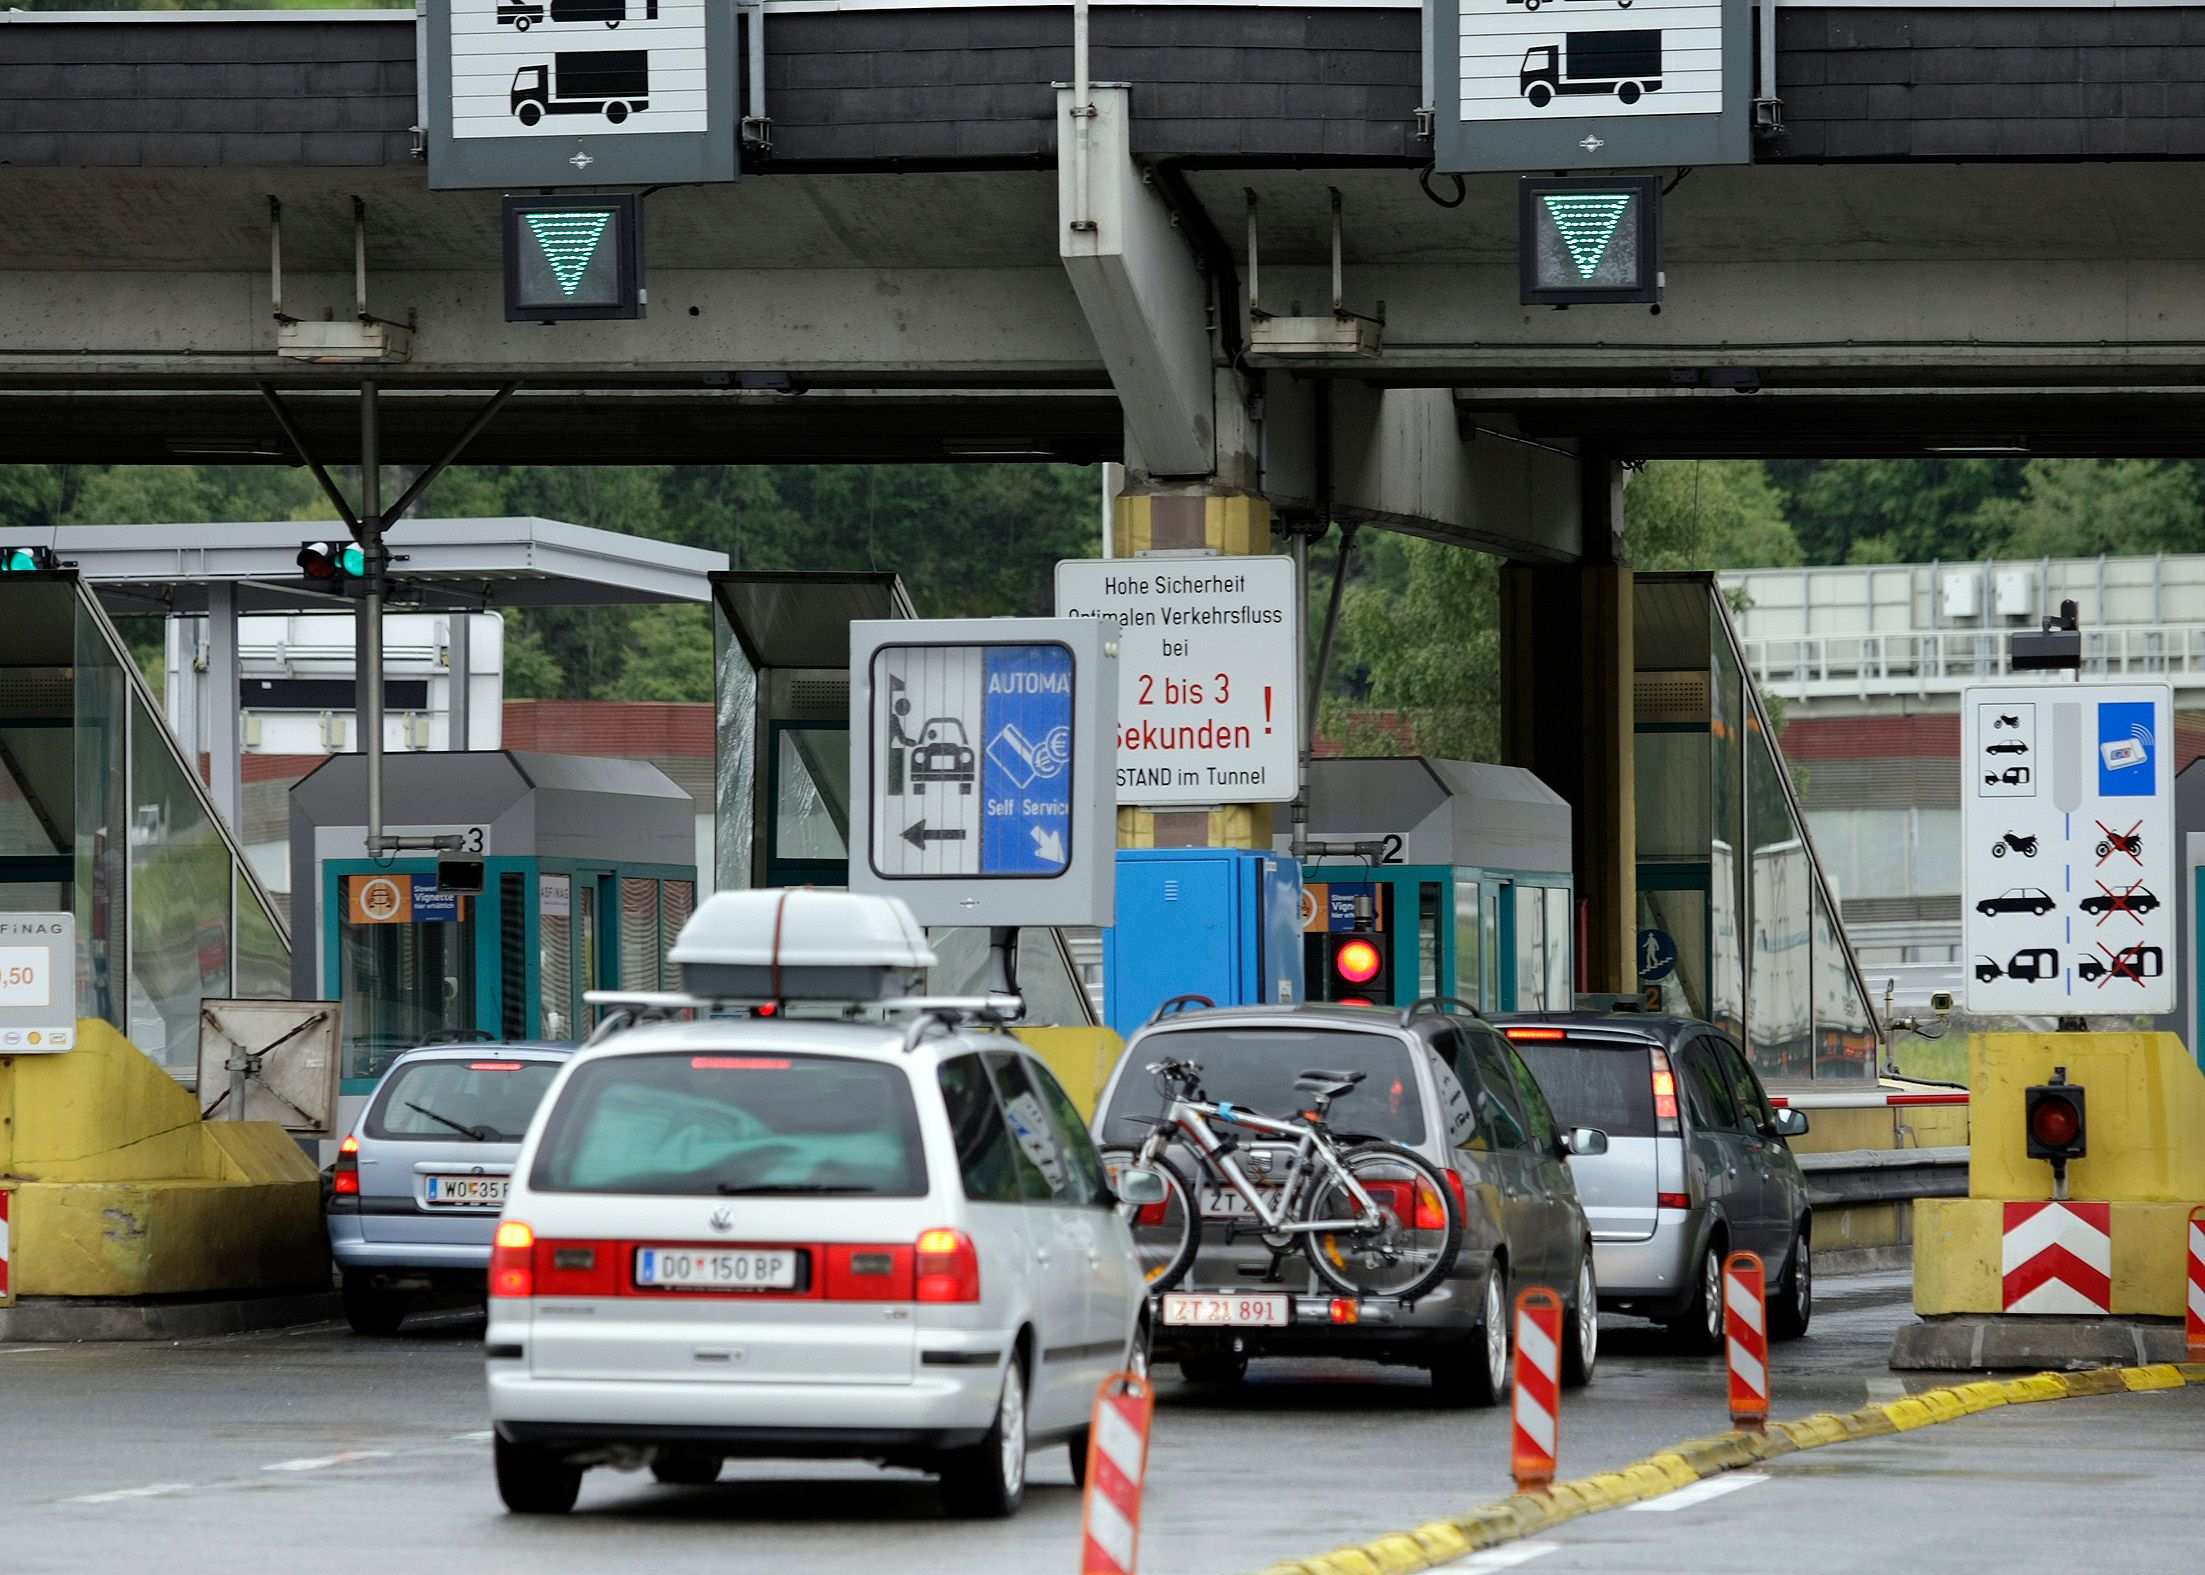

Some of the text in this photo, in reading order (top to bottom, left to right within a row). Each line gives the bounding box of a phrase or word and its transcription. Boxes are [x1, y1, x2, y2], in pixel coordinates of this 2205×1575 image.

[1105, 575, 1245, 595] Hohe Sicherheit
[1160, 604, 1283, 625] Verkehrsfluss
[1162, 639, 1189, 657] bei
[988, 671, 1072, 695] AUTOMA
[1138, 673, 1230, 705] 2 bis 3
[1177, 768, 1200, 786] im
[1206, 766, 1266, 786] Tunnel
[987, 798, 1070, 817] Self Servic
[468, 827, 484, 853] 3
[1382, 833, 1404, 864] 2
[0, 966, 34, 989] ,50
[1647, 986, 1660, 1010] 2
[445, 1181, 467, 1198] WO
[479, 1181, 499, 1198] 35
[1210, 1193, 1237, 1212] ZT
[661, 1255, 783, 1282] DO 150 BP
[1176, 1300, 1275, 1321] ZT 21 891
